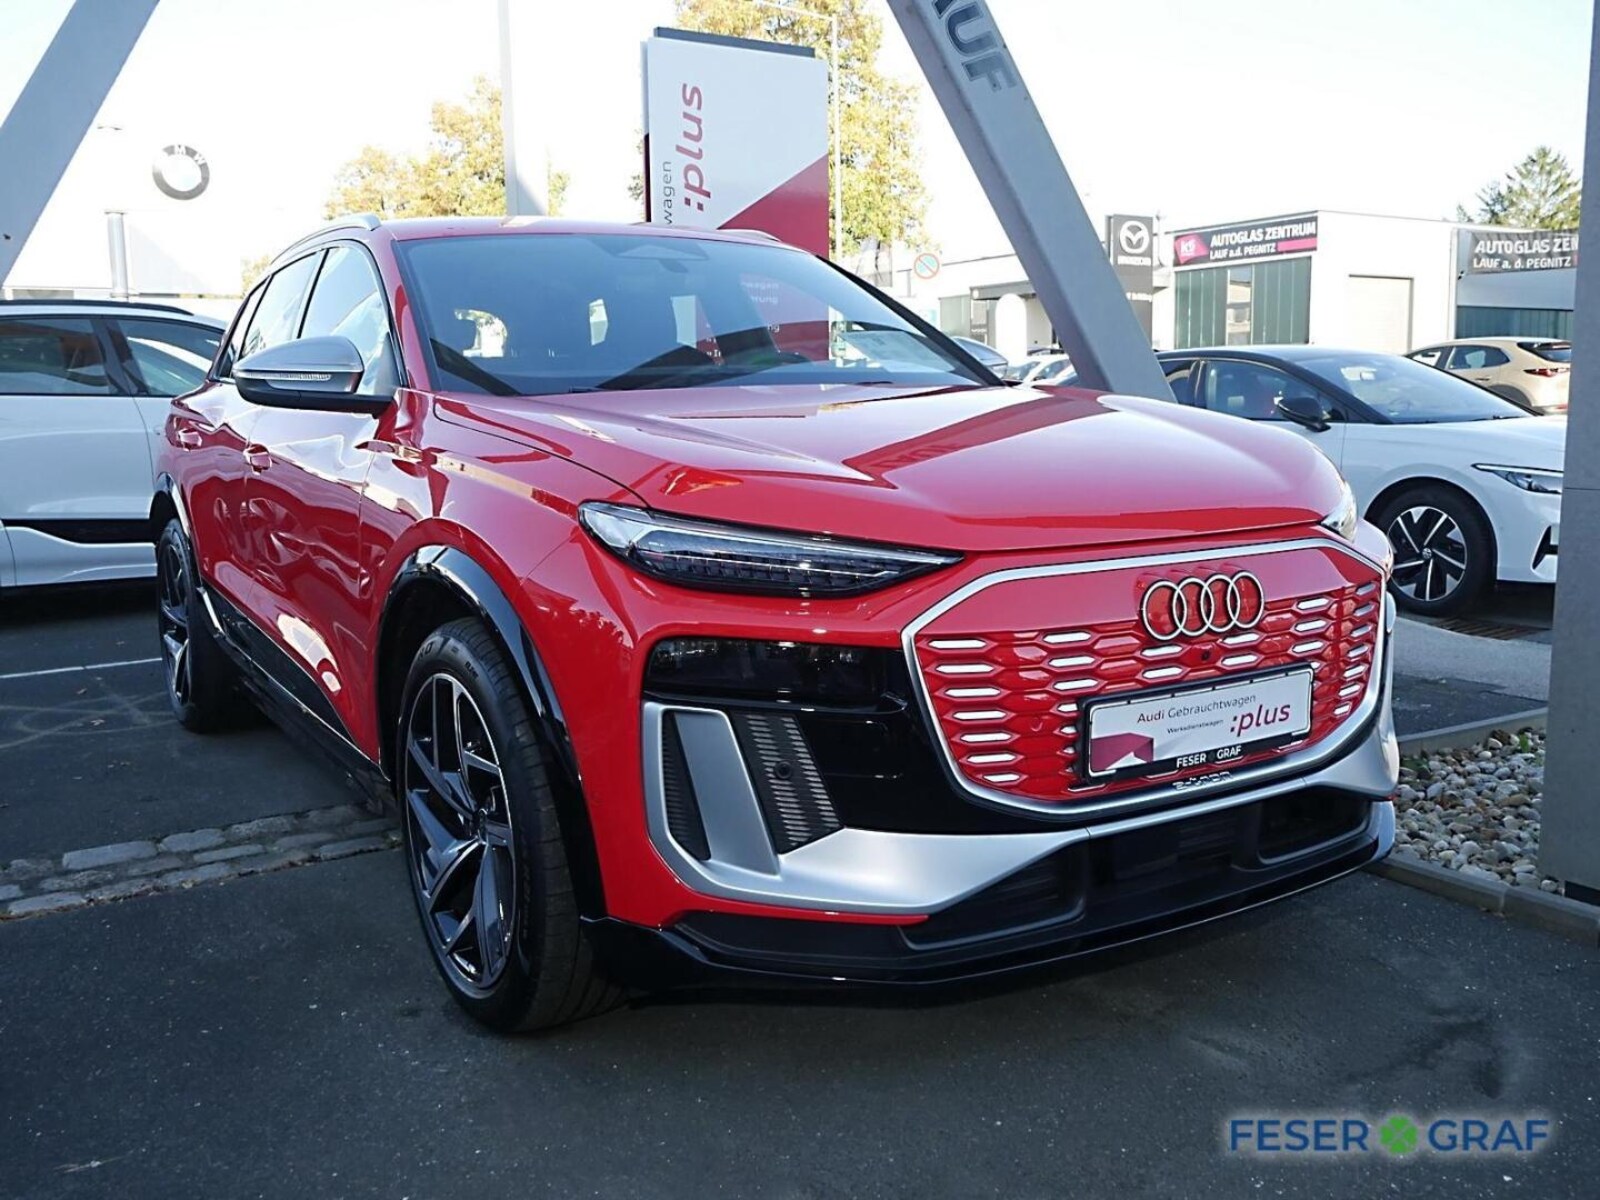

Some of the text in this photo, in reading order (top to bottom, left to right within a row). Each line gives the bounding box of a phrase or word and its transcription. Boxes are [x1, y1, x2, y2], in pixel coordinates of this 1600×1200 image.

[932, 0, 1017, 92] UF
[675, 83, 711, 212] :plus
[662, 161, 675, 225] wagen
[1210, 221, 1316, 248] AUTOGLAS ZENTRUM
[1474, 239, 1551, 254] AUTOGLAS
[1209, 248, 1229, 260] LAUF
[1243, 242, 1277, 256] PEGNITZ
[1473, 257, 1500, 269] LAUF
[1526, 256, 1571, 269] PEGNITZ
[1136, 694, 1257, 724] Audi Gebrauchtwagen
[1229, 703, 1292, 738] :plus
[1176, 745, 1243, 769] FESER GRAF
